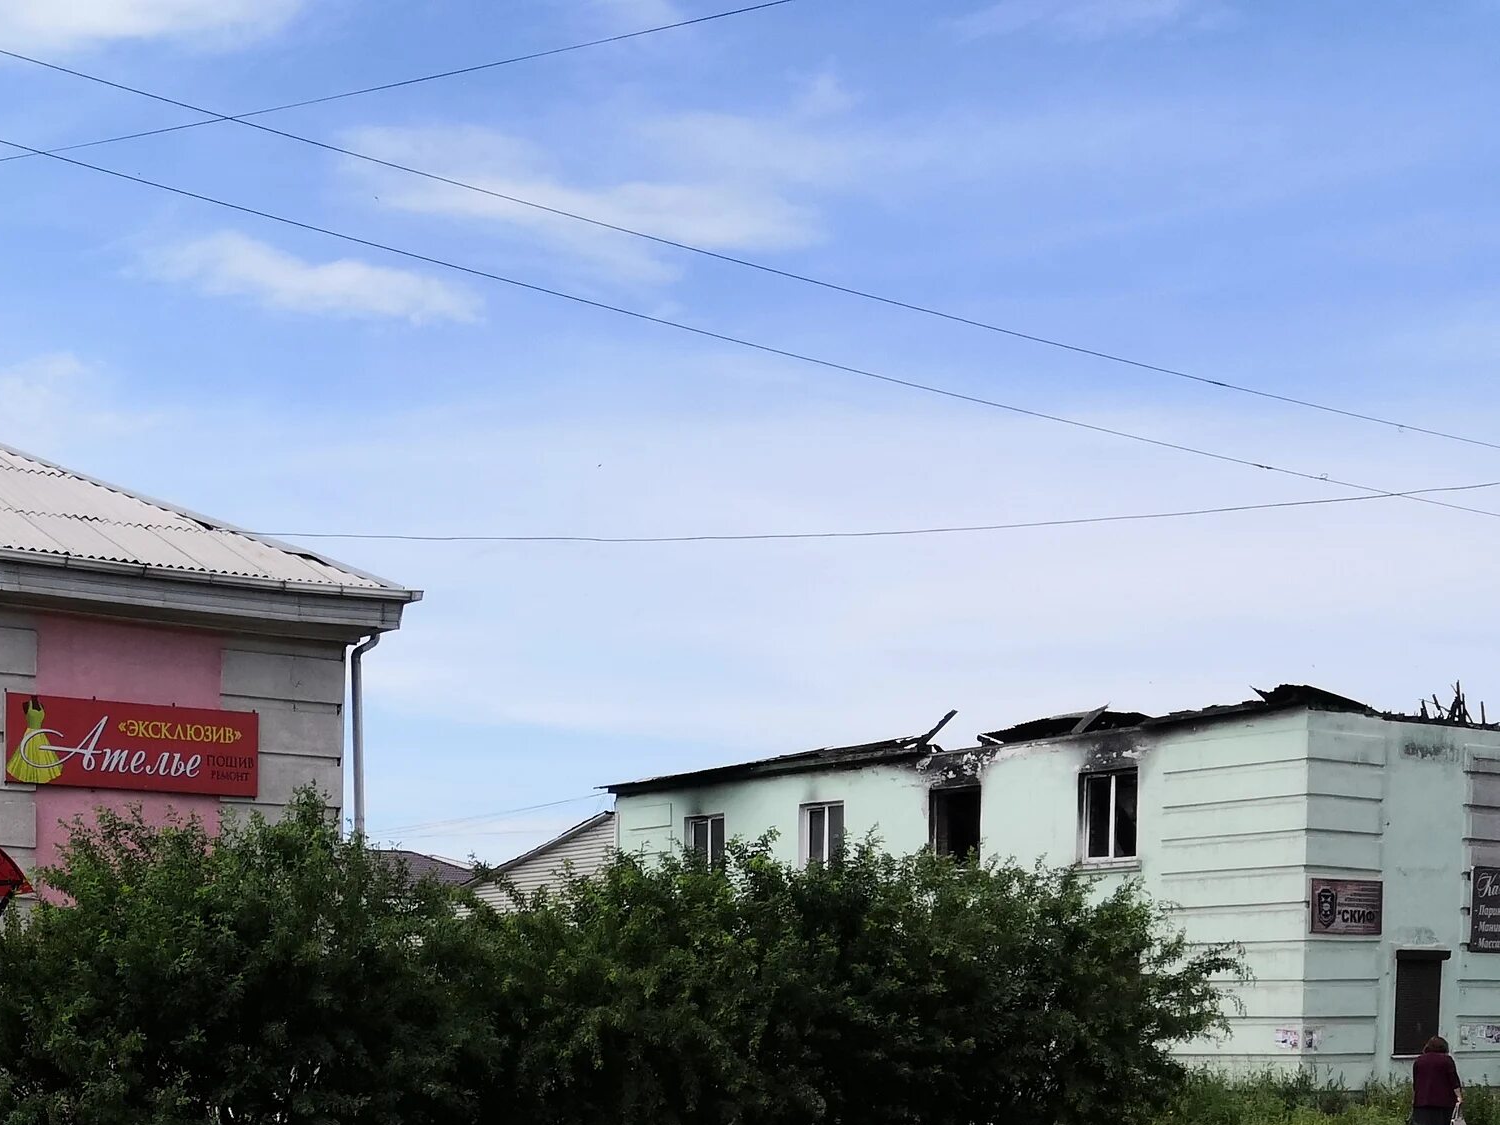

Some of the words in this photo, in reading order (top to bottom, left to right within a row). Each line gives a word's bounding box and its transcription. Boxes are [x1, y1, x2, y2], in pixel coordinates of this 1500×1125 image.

[118, 719, 242, 744] «ЭКСКЛЮЗИВ»
[20, 715, 201, 778] Ателье
[206, 754, 254, 769] ПОШИВ
[1477, 872, 1500, 898] Ка
